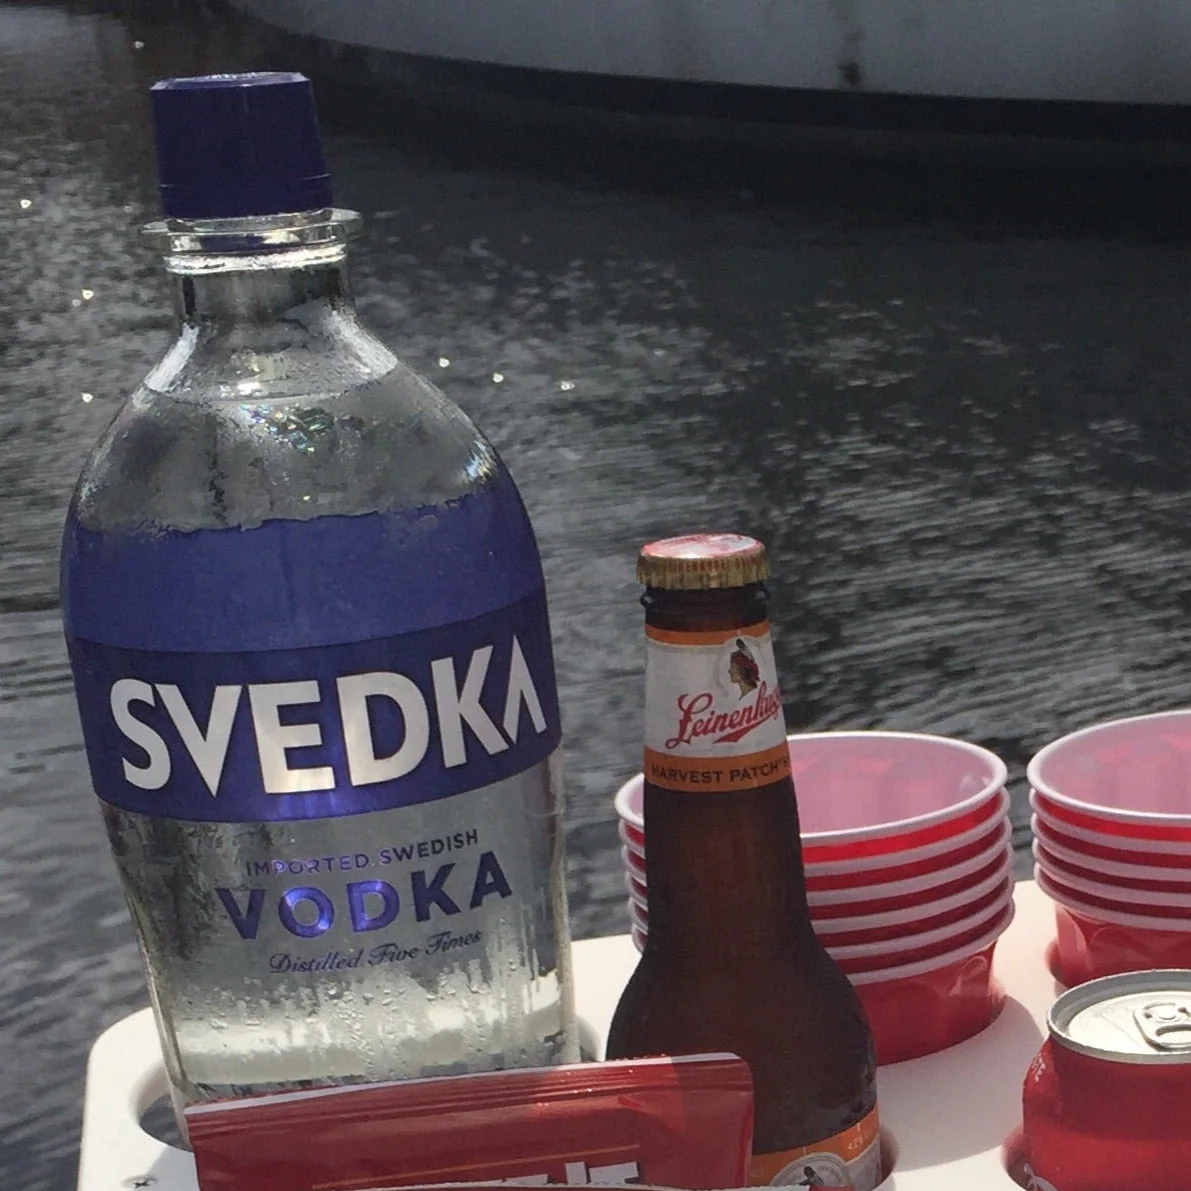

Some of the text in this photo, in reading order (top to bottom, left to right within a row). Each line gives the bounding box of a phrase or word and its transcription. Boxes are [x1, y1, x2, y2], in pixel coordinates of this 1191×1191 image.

[110, 635, 548, 797] SVEDKA
[651, 764, 723, 783] HARVEST
[729, 763, 780, 782] PATCH
[246, 829, 479, 877] IMPORTED SWEDISH
[215, 851, 513, 940] VODKA
[269, 929, 482, 975] Distilled Five Times
